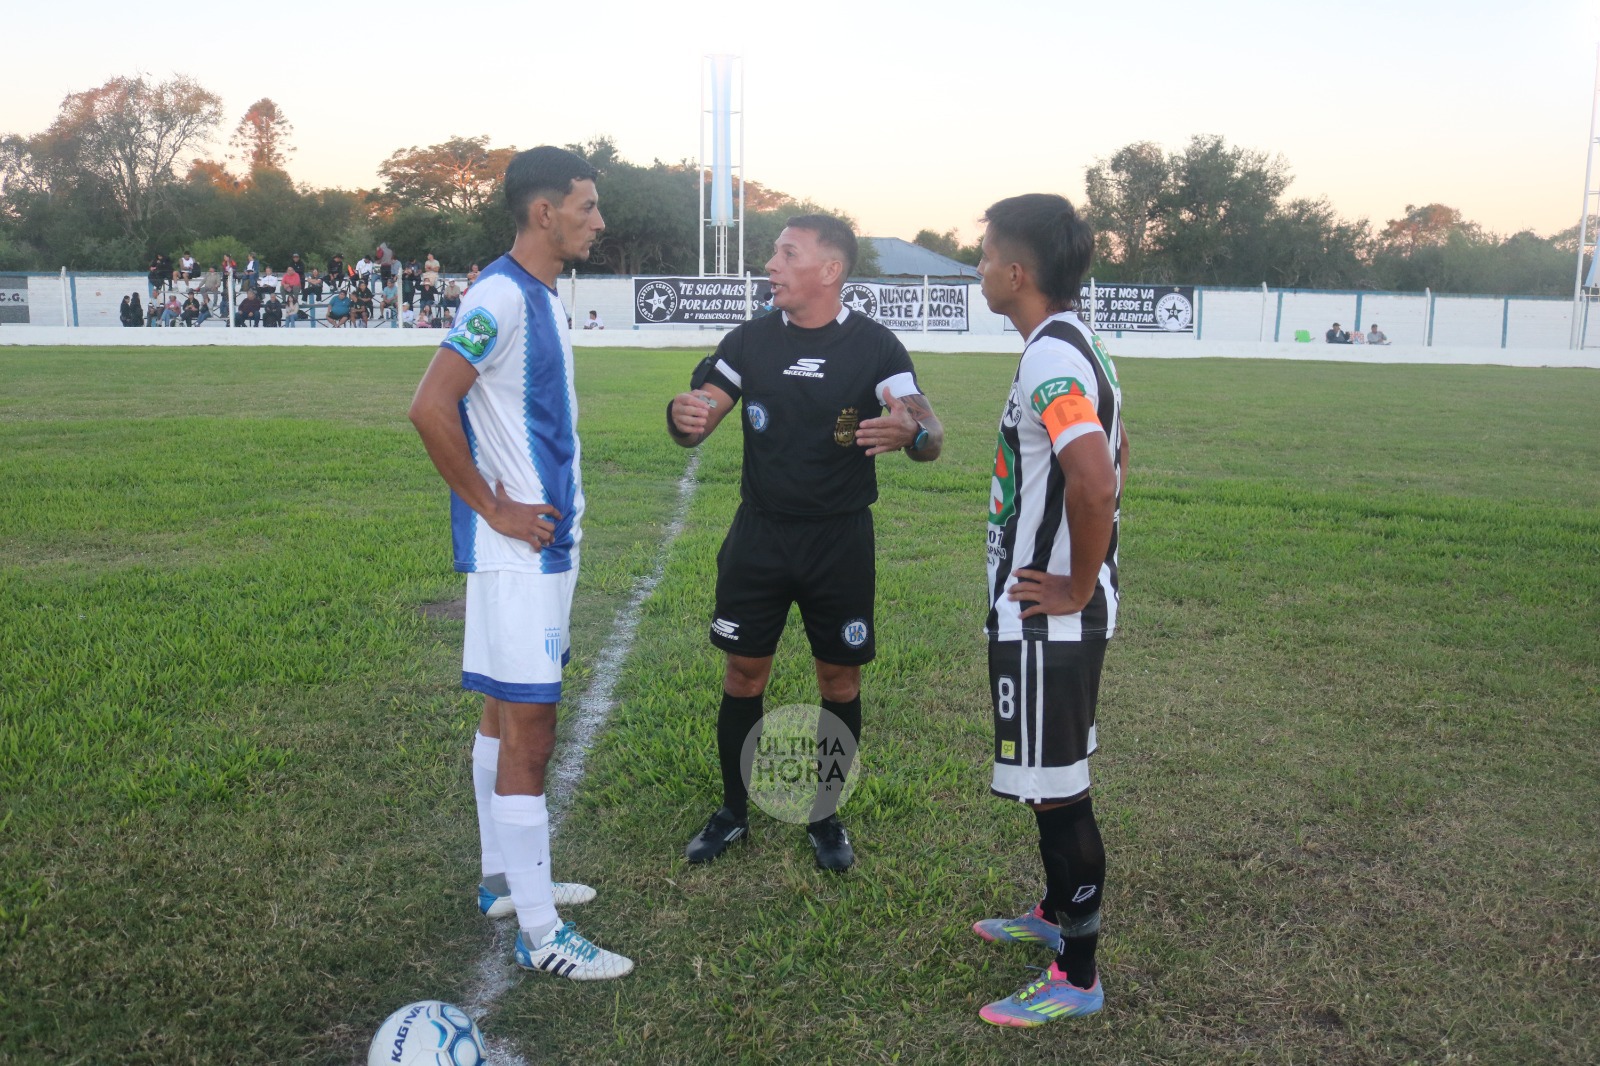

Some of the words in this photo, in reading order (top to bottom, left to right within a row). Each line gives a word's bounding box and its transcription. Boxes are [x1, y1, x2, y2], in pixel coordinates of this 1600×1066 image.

[655, 283, 675, 301] CENTRAL
[680, 283, 694, 295] TE
[695, 283, 721, 296] SIGO
[855, 285, 876, 305] CENTRAL
[879, 288, 919, 304] NUNCA
[1118, 289, 1139, 299] NOS
[1140, 289, 1155, 300] VA
[679, 299, 701, 310] POR
[701, 299, 722, 311] LAS
[723, 299, 758, 311] DUDS
[880, 304, 914, 318] ESTE
[1110, 300, 1141, 312] DESDE
[1143, 301, 1154, 312] EL
[1109, 312, 1117, 322] A
[1119, 313, 1154, 323] ALENTAR
[783, 369, 824, 379] SKECHERS
[1053, 398, 1084, 427] C
[998, 676, 1015, 720] 8
[391, 1005, 426, 1063] KAGIVA
